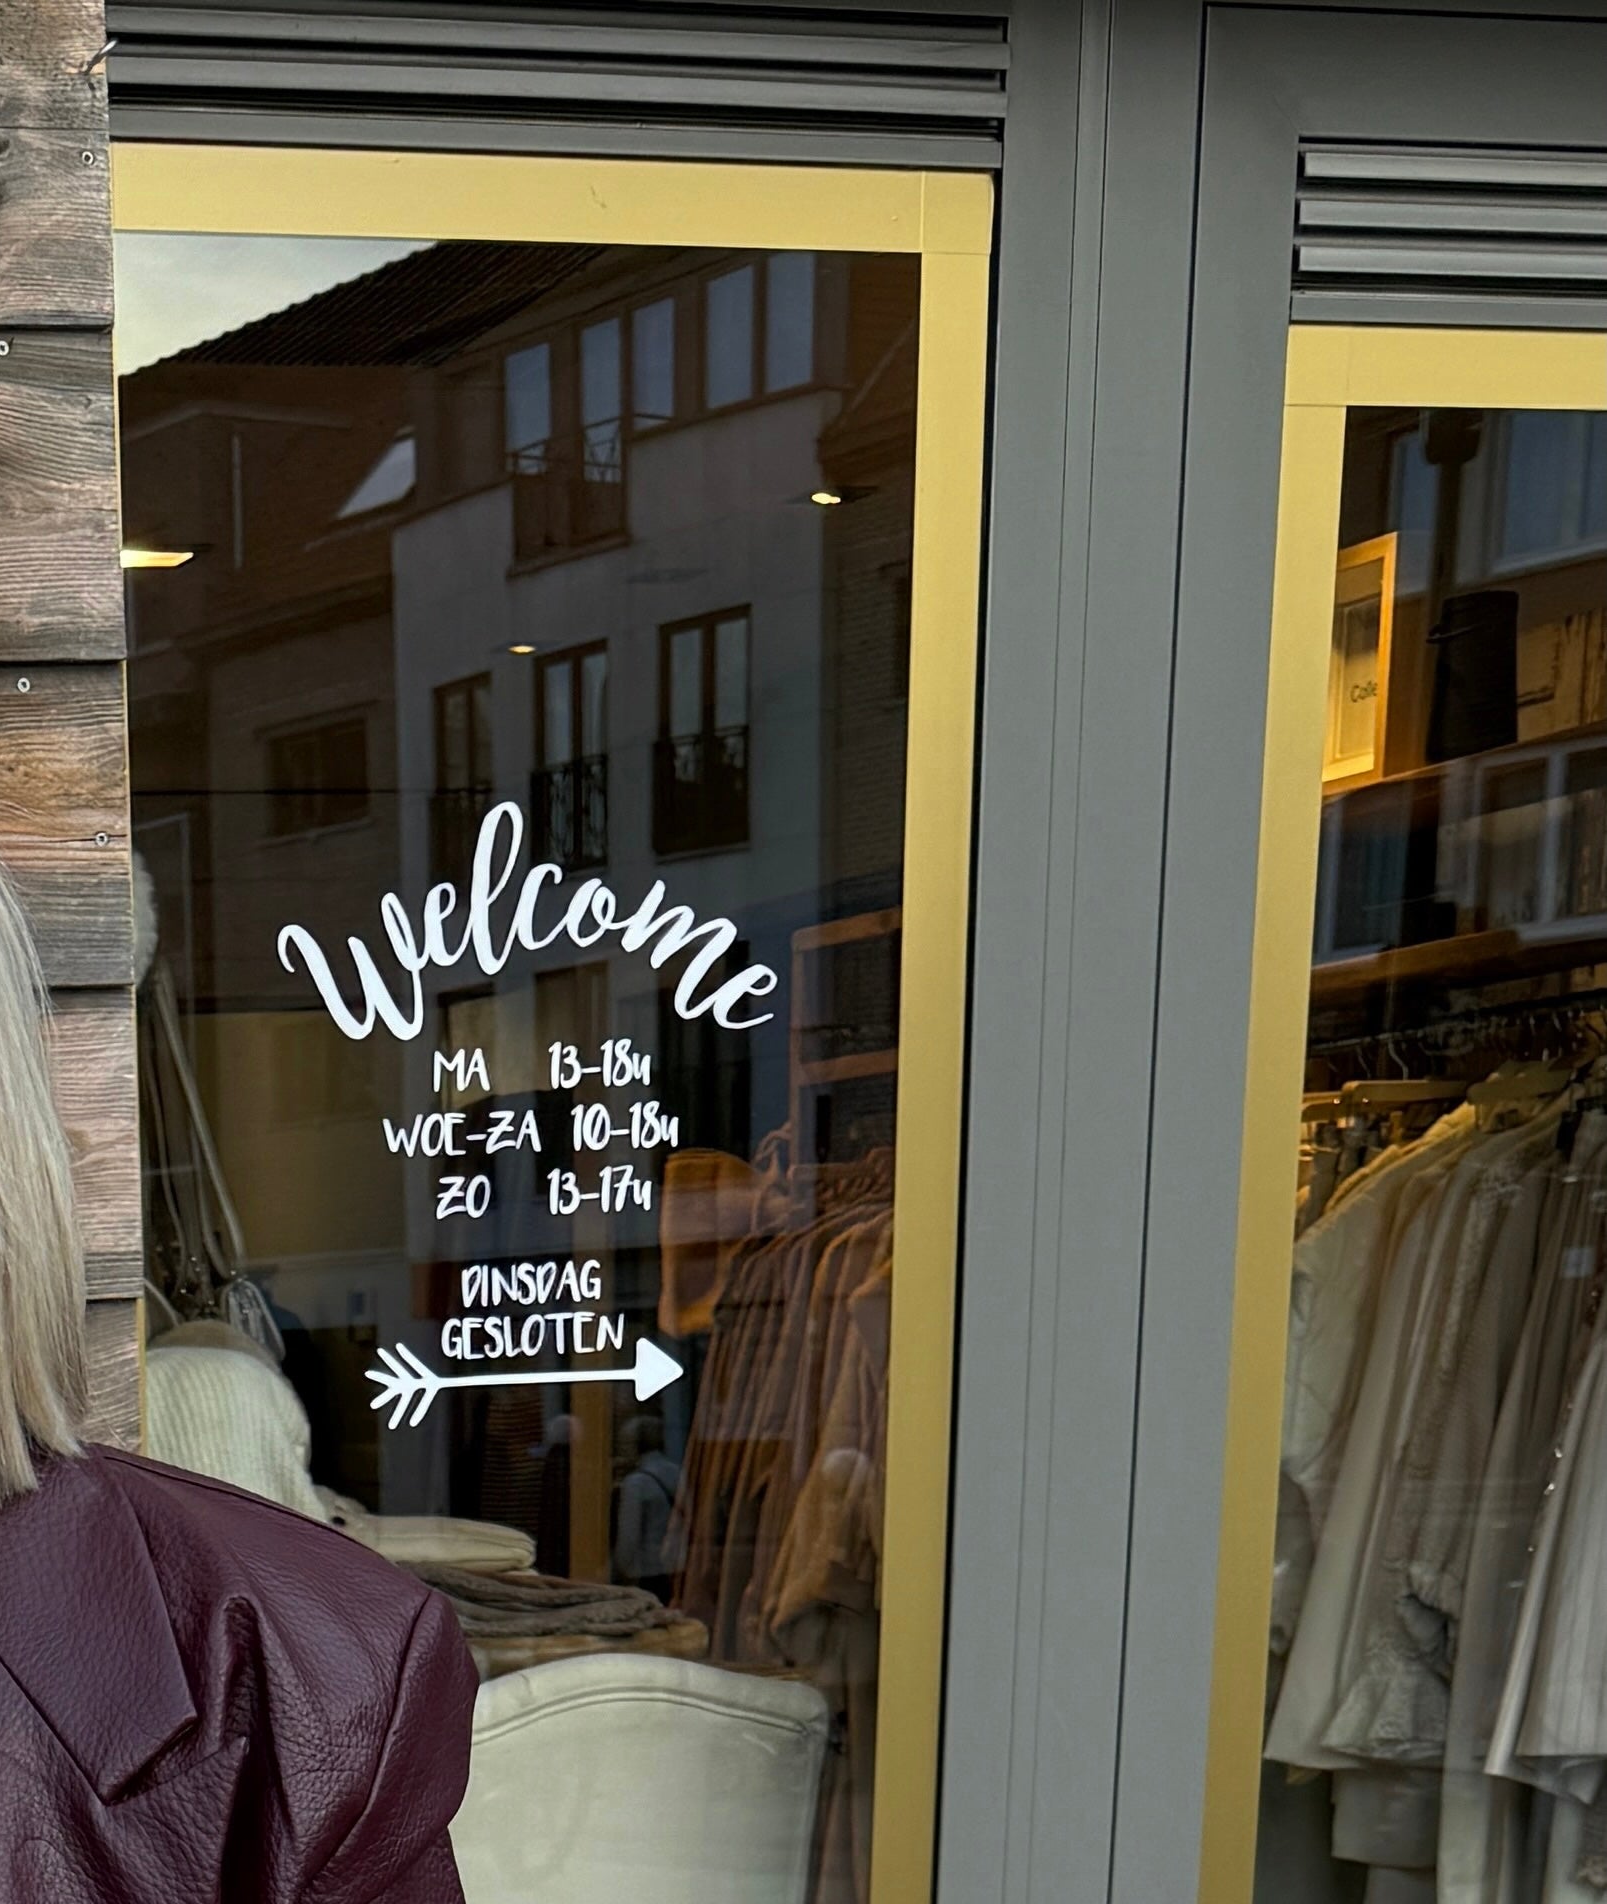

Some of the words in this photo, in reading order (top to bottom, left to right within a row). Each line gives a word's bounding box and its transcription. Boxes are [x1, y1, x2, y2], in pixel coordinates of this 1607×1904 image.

[278, 802, 777, 1040] Welcome
[434, 1048, 490, 1092] MA
[549, 1039, 651, 1089] 13-18u
[383, 1110, 541, 1157] WOE-ZA
[437, 1175, 490, 1219] ZO
[548, 1167, 652, 1214] 13-17u
[461, 1259, 601, 1308] DINSDAG
[441, 1311, 624, 1360] GESLOTEN
